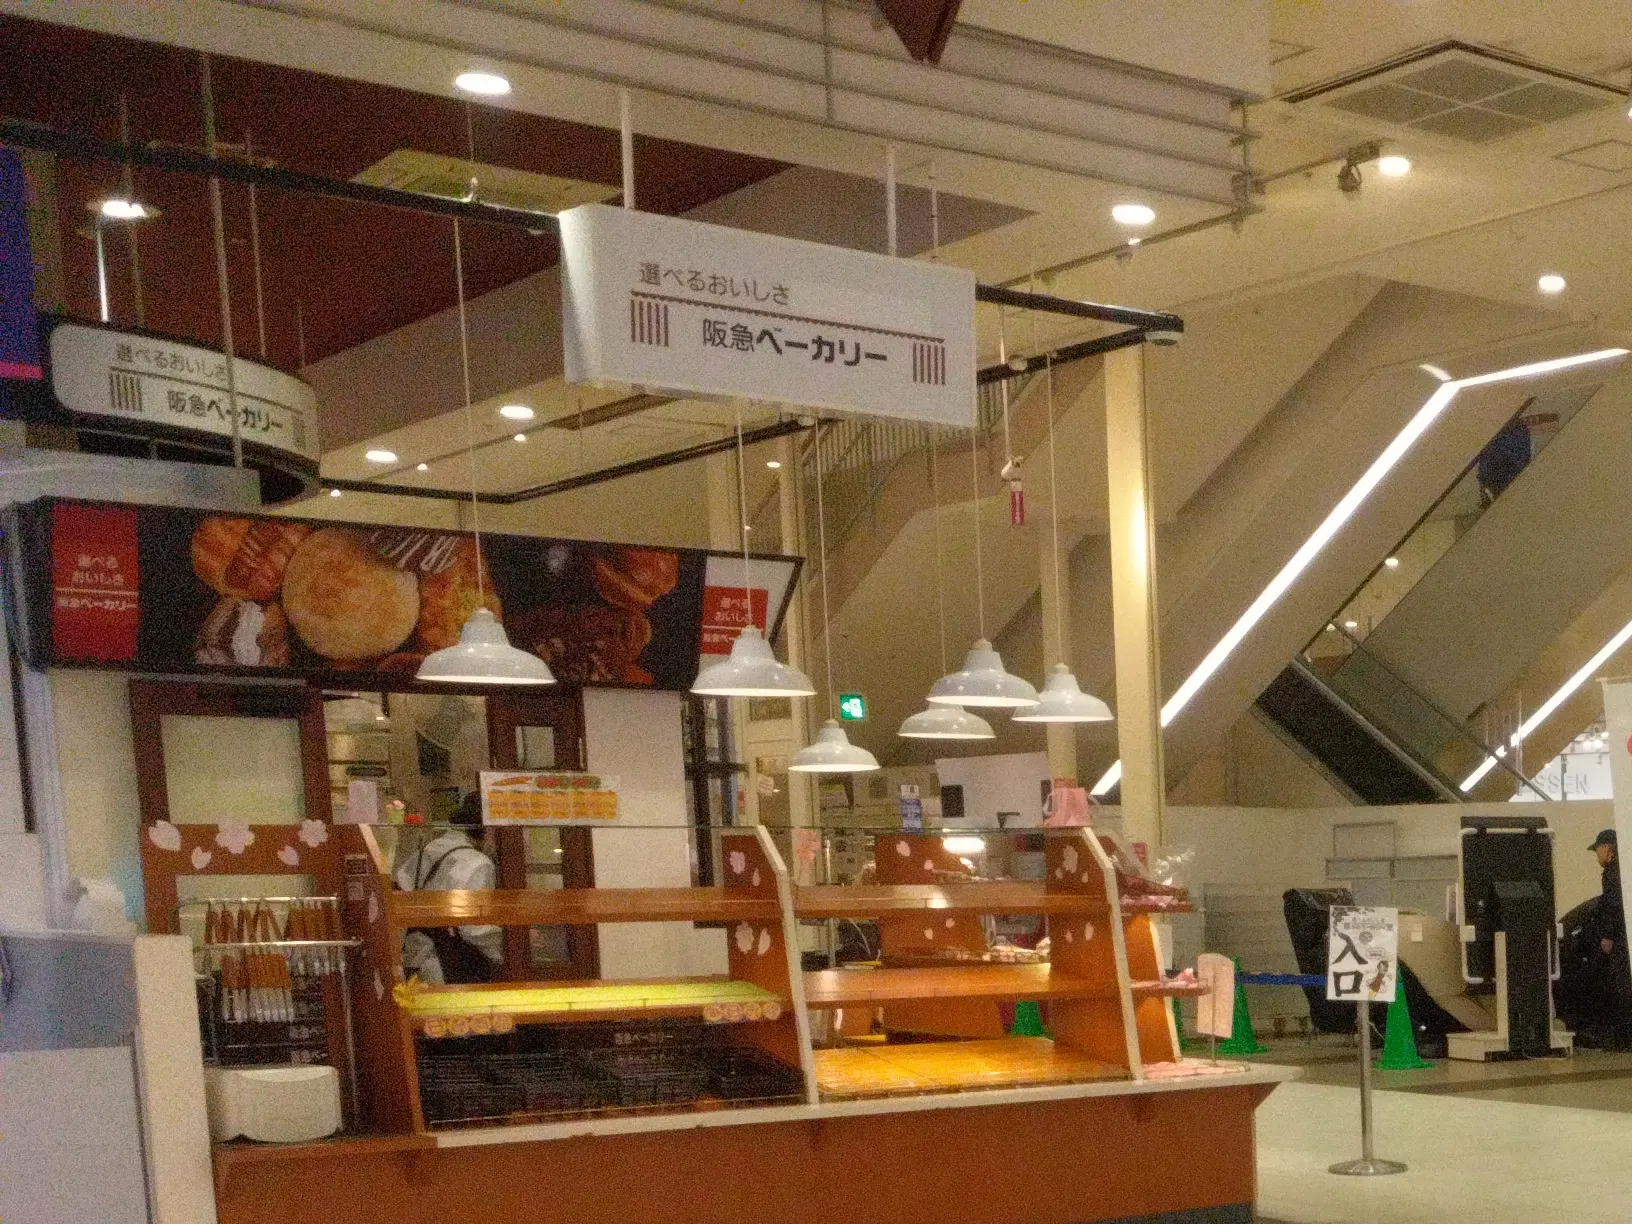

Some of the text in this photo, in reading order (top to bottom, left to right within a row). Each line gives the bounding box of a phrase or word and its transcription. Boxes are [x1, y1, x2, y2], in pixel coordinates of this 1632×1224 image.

[639, 262, 790, 305] 選べるおいしさ
[116, 343, 229, 381] 選べるおいしさ
[702, 318, 888, 366] 阪急ベーカリー
[1331, 931, 1369, 998] 入口
